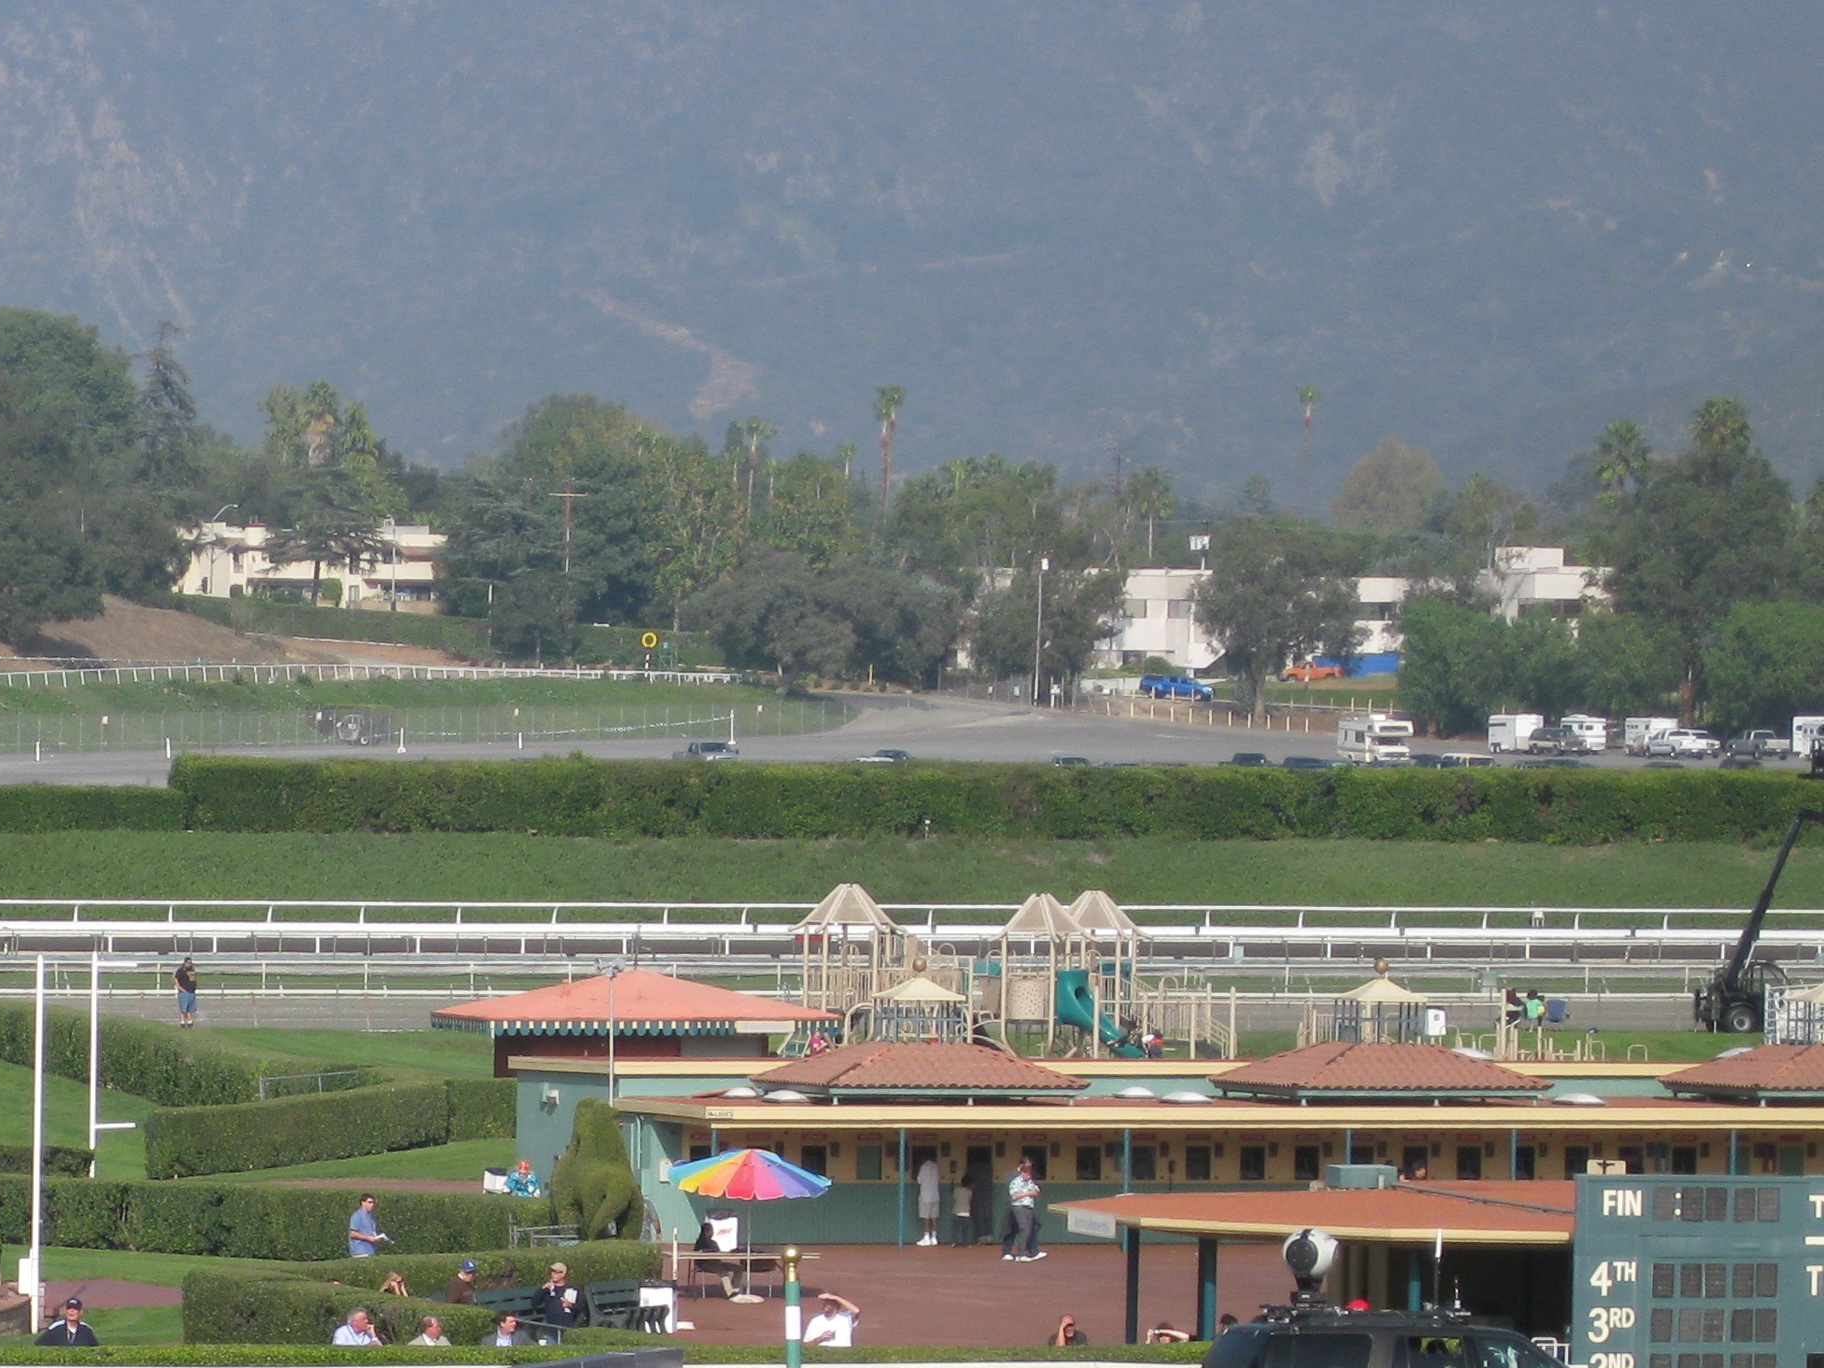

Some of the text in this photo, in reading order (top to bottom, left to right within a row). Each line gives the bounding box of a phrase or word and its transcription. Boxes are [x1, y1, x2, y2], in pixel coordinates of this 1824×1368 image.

[1602, 1189, 1643, 1217] FIN
[1589, 1261, 1636, 1297] 4TH
[1587, 1306, 1635, 1344] 3RD
